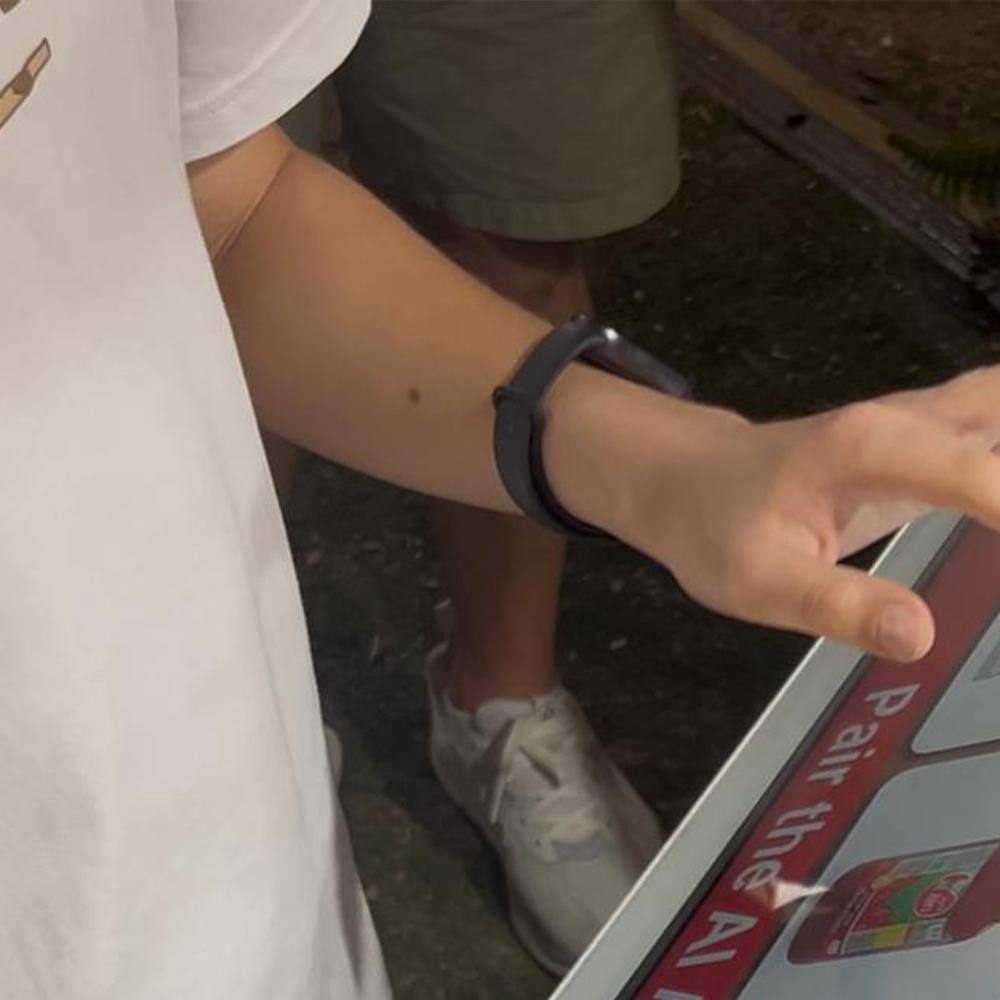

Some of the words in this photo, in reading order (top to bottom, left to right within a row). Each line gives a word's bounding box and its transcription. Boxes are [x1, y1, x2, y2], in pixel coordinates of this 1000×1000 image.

[807, 683, 921, 786] Pair
[732, 800, 834, 894] the
[676, 909, 759, 969] Al
